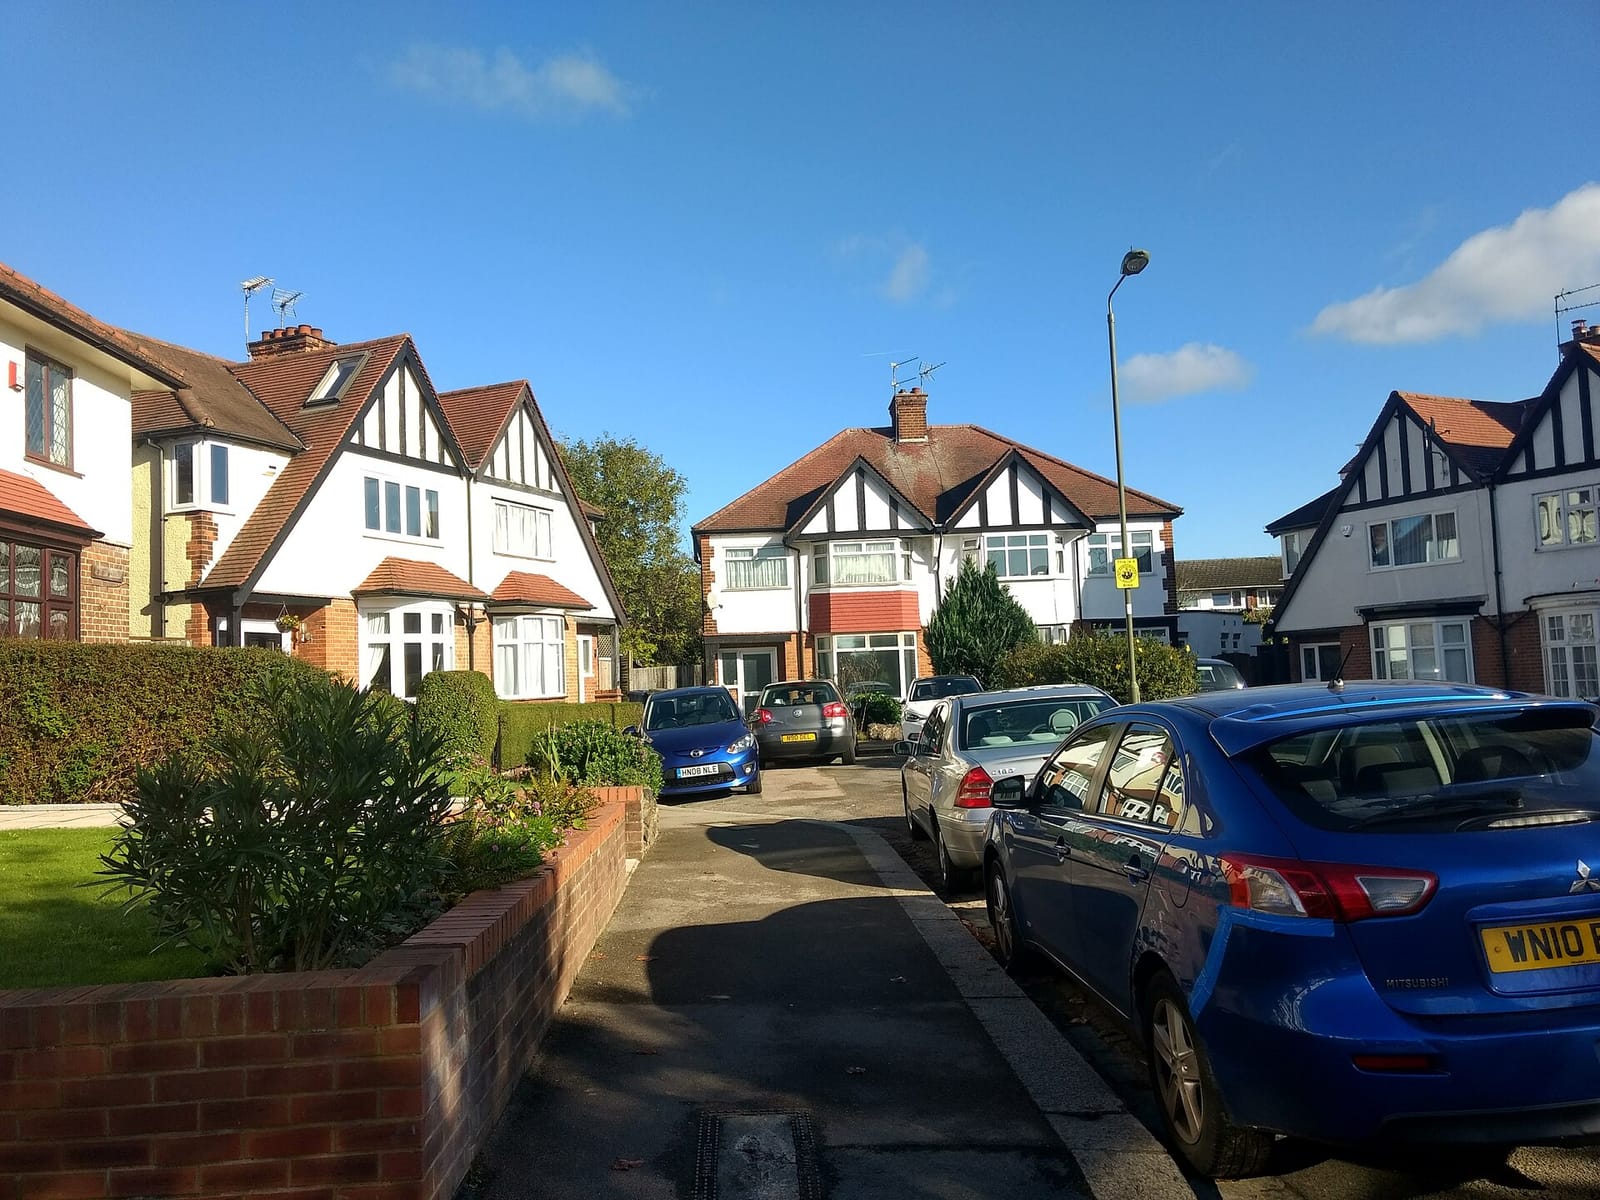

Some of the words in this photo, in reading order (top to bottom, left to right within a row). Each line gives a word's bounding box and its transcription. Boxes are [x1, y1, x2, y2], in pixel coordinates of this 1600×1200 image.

[681, 767, 702, 777] HN08
[702, 765, 718, 774] NLE
[1503, 925, 1584, 963] WN10
[1386, 977, 1449, 989] MITSUBISHI
